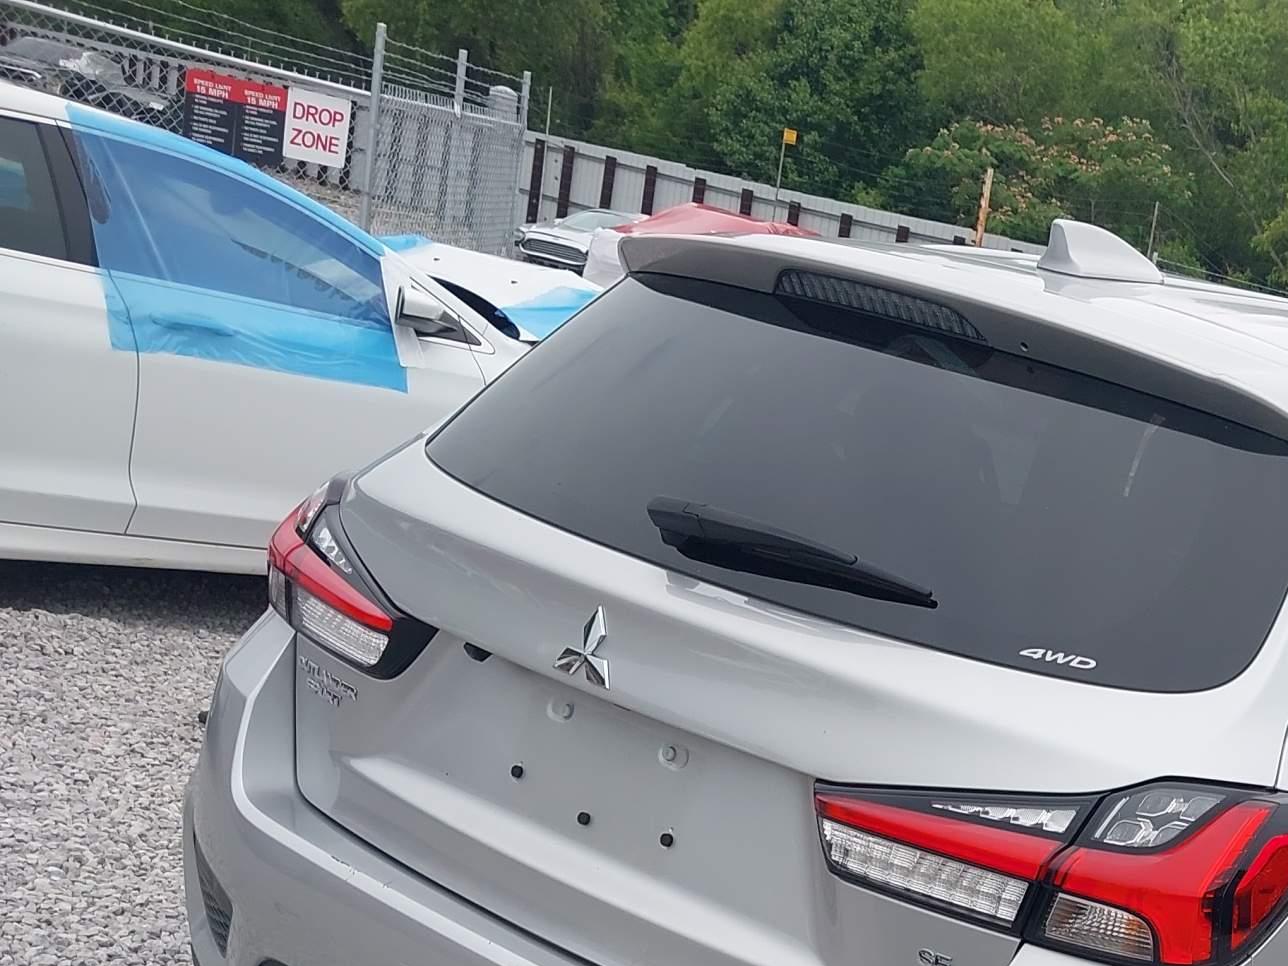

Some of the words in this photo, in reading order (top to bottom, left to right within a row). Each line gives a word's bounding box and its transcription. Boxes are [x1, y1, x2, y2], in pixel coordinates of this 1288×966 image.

[193, 78, 214, 87] SPEED
[196, 85, 206, 94] 15
[208, 88, 229, 99] MPH
[244, 89, 264, 98] SPEED
[247, 97, 257, 105] 15
[258, 99, 279, 110] MPH
[293, 102, 344, 127] DROP
[290, 128, 340, 154] ZONE
[1019, 648, 1097, 669] 4WD
